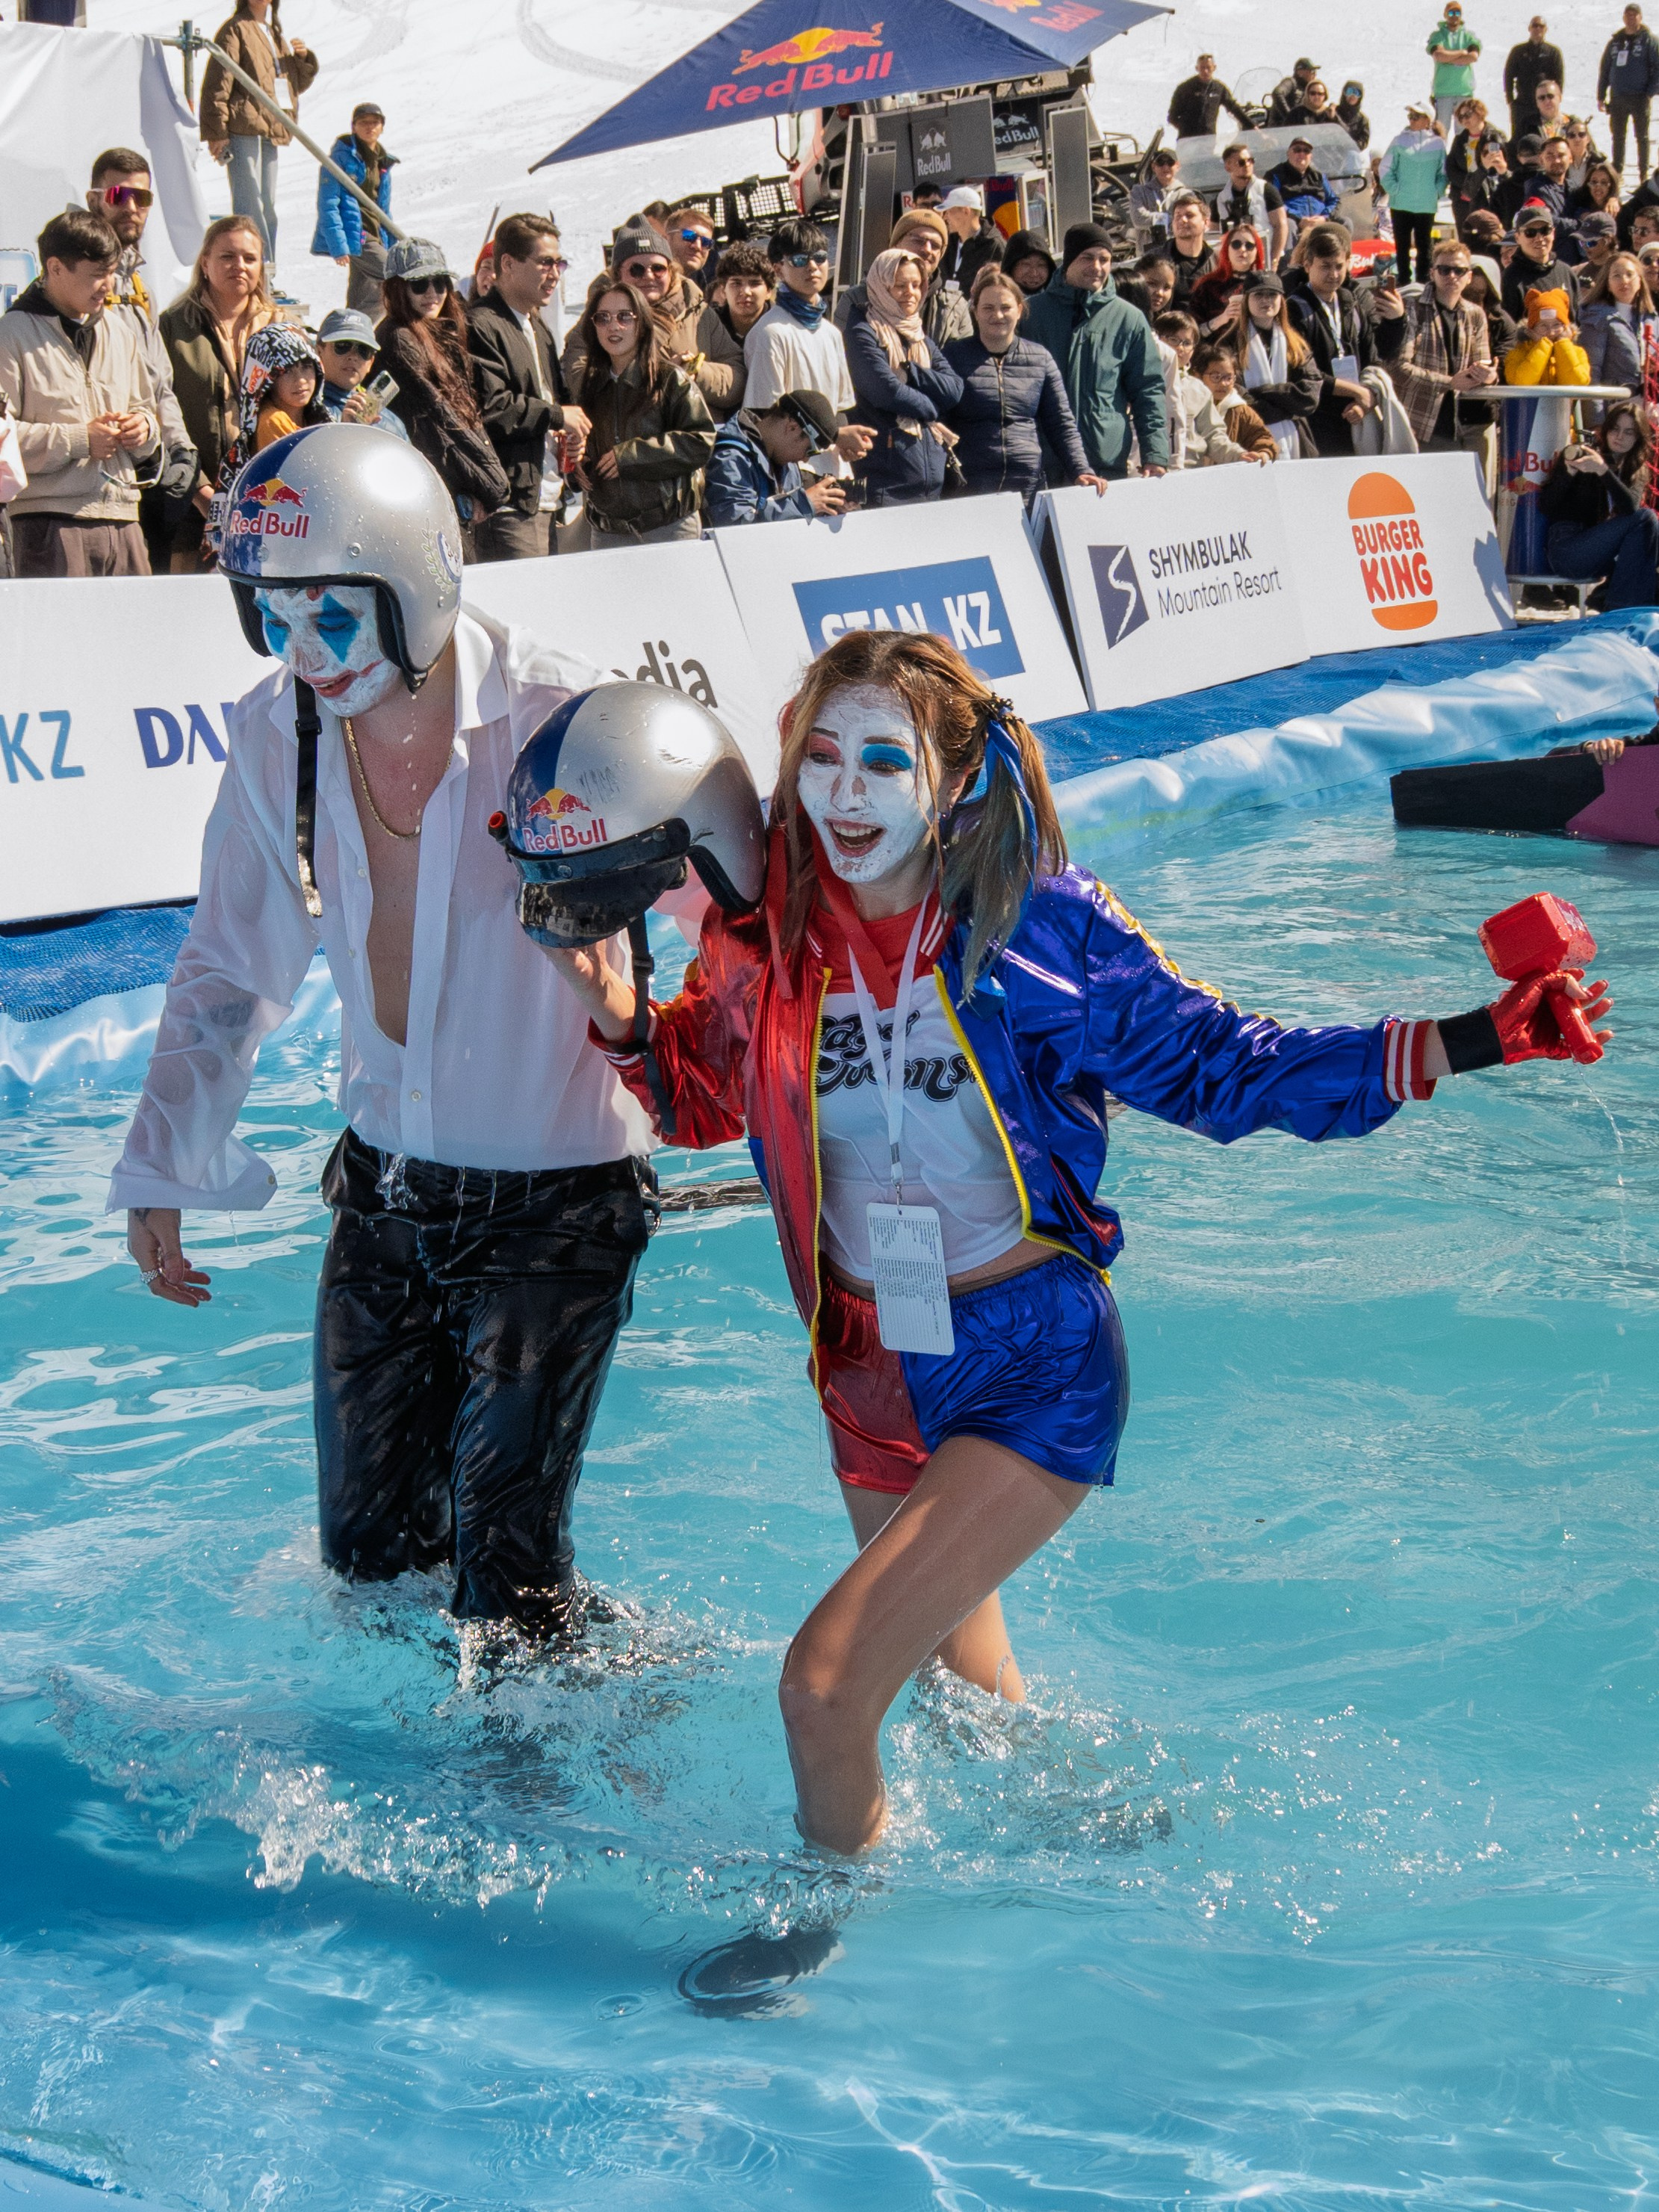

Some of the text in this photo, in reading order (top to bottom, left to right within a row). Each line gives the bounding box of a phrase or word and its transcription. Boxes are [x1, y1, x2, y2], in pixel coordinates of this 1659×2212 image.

[705, 51, 893, 111] Red Bull
[994, 126, 1039, 145] ed Bull
[917, 152, 952, 177] Red Bull
[1525, 451, 1560, 473] Bu
[230, 509, 264, 535] Red
[265, 512, 311, 539] Bull
[1351, 519, 1424, 556] BURGER
[1149, 530, 1253, 579] SHYMBULAK
[1360, 552, 1433, 604] KING
[1157, 566, 1282, 619] Mountain Resort
[610, 640, 719, 708] dia
[0, 710, 86, 784] KZ
[133, 701, 235, 769] DA
[522, 817, 607, 852] Red Bull
